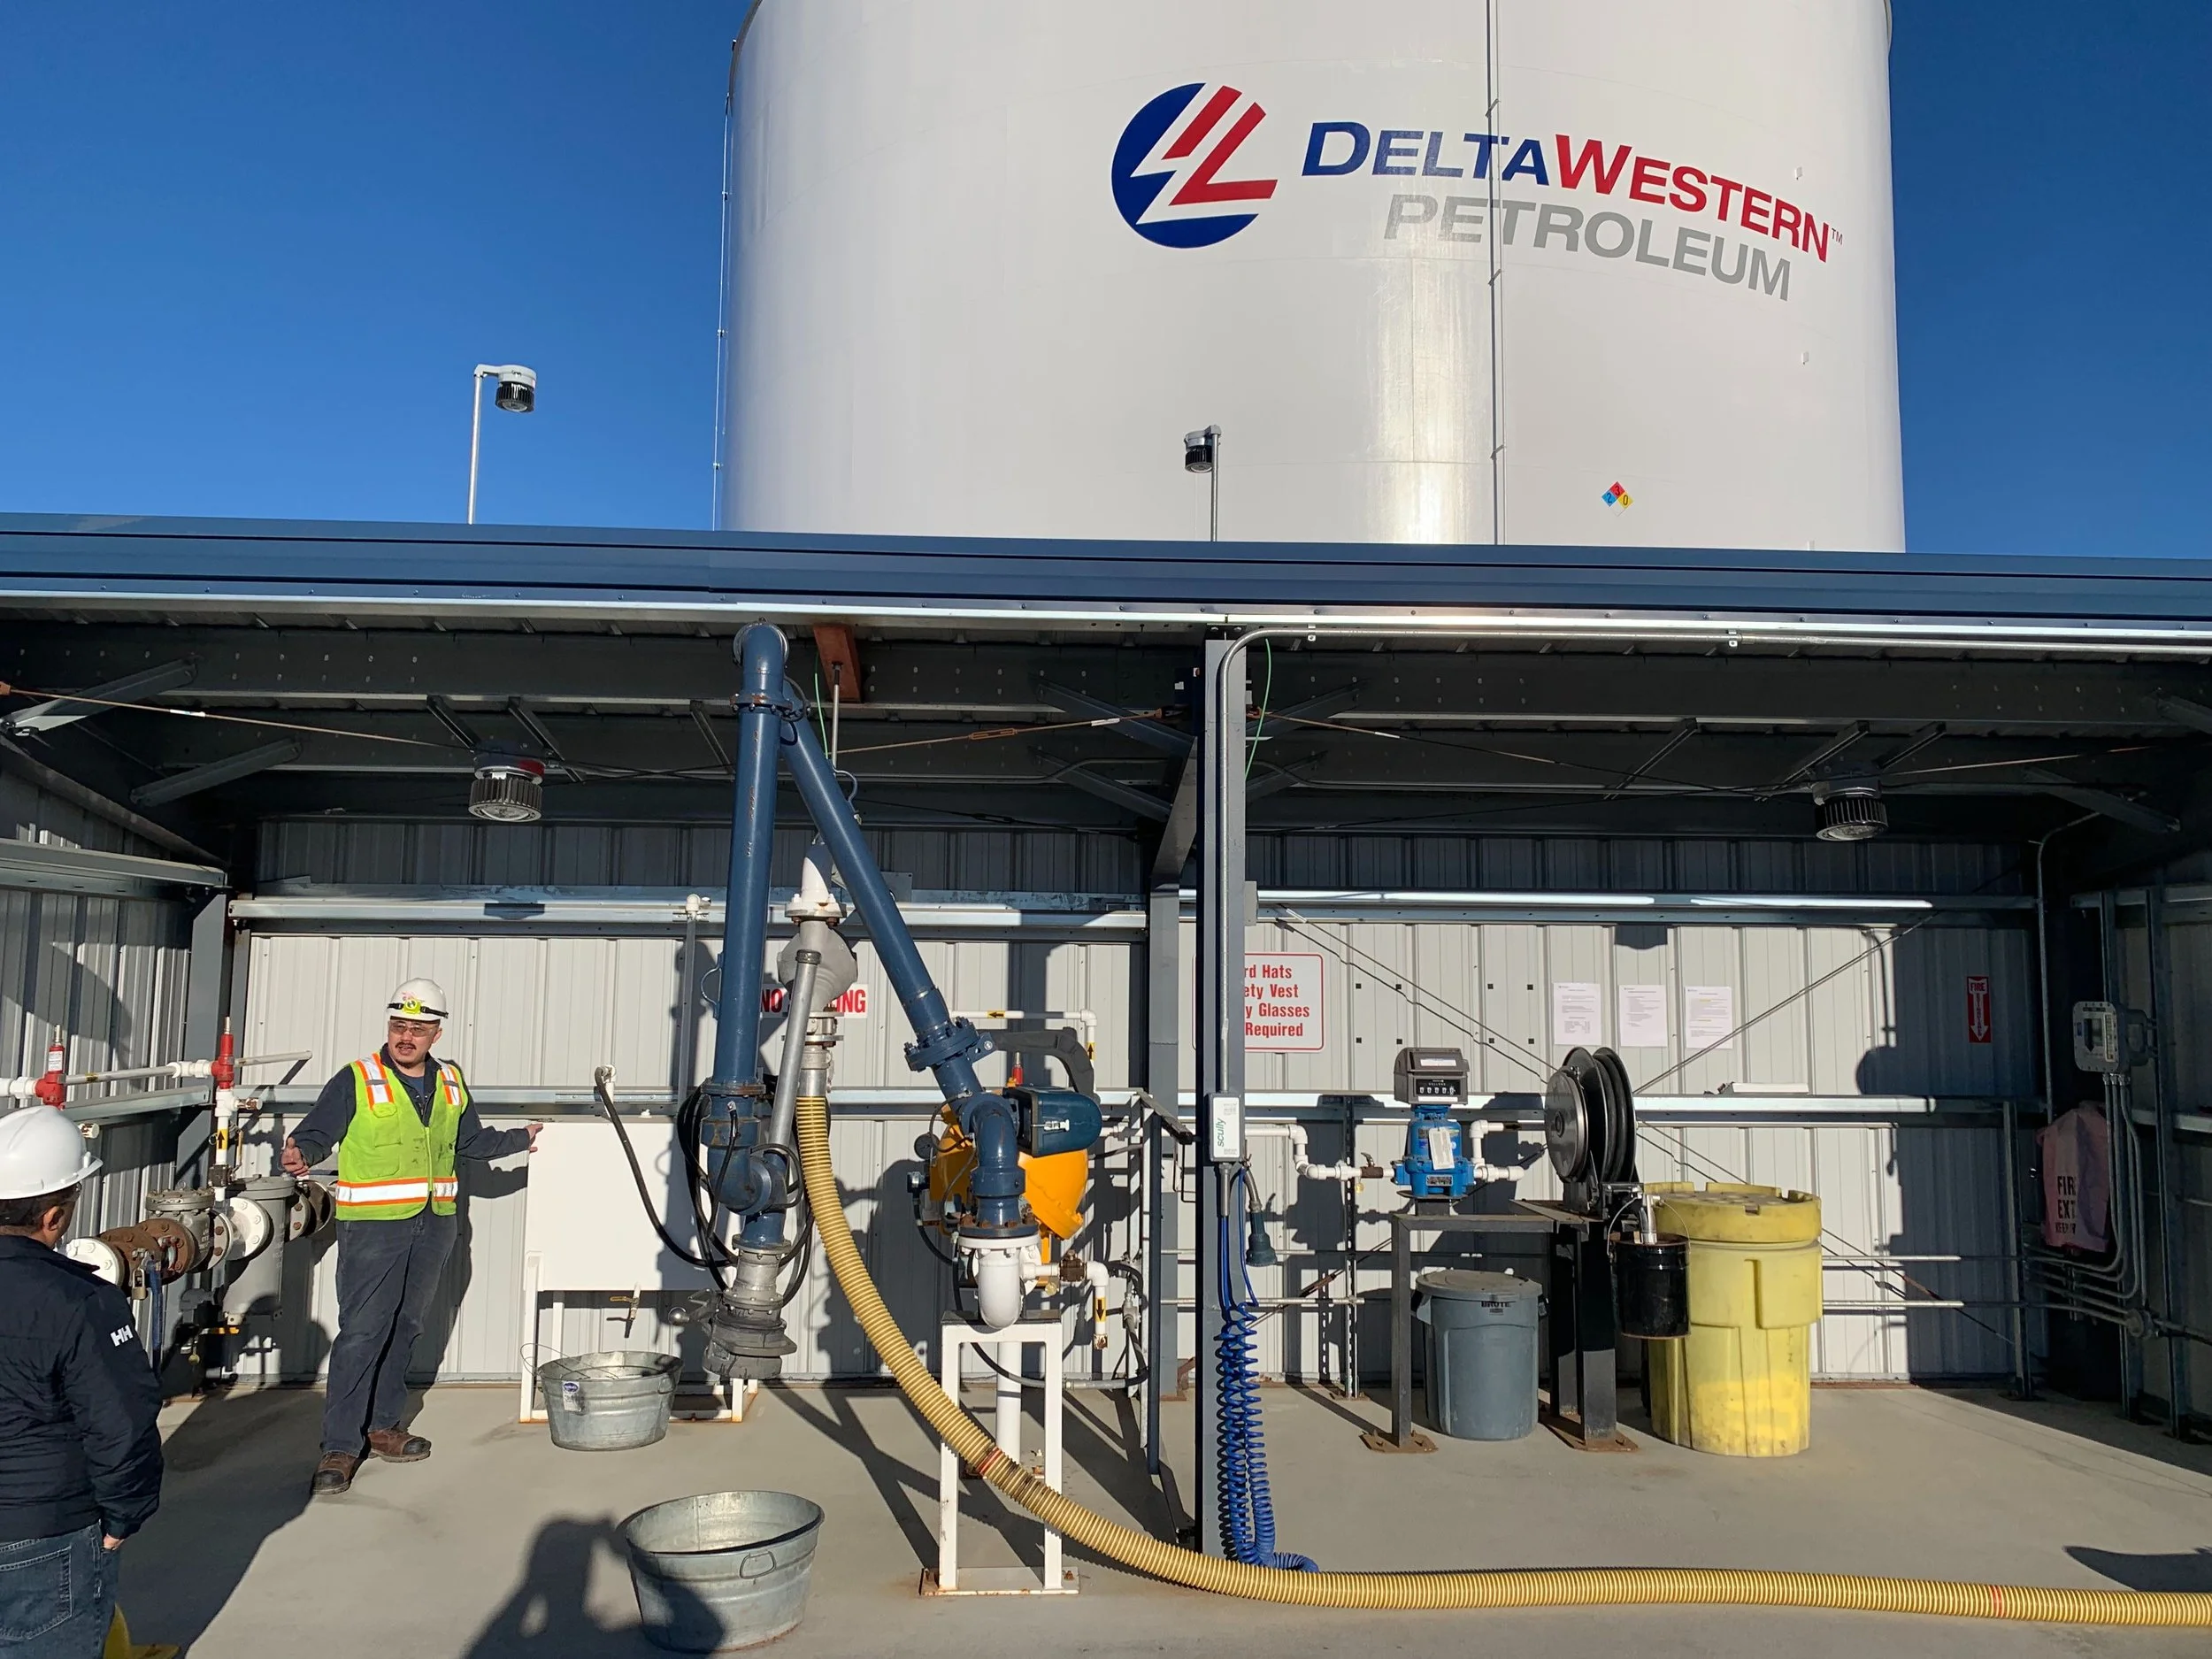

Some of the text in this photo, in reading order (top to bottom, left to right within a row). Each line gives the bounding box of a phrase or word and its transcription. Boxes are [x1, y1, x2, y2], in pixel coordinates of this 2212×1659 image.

[1384, 194, 1791, 302] PETROLEUM
[1607, 492, 1612, 503] 2
[1615, 485, 1620, 495] 3
[1623, 495, 1628, 505] 0
[1244, 964, 1292, 979] rd Hats
[1244, 984, 1299, 1000] ety Vest
[761, 988, 783, 1013] NO
[1258, 1002, 1310, 1018] Glasses
[1245, 1022, 1303, 1039] Required
[1216, 1118, 1226, 1148] scully
[2057, 1175, 2077, 1196] FIR
[110, 1325, 134, 1347] HH
